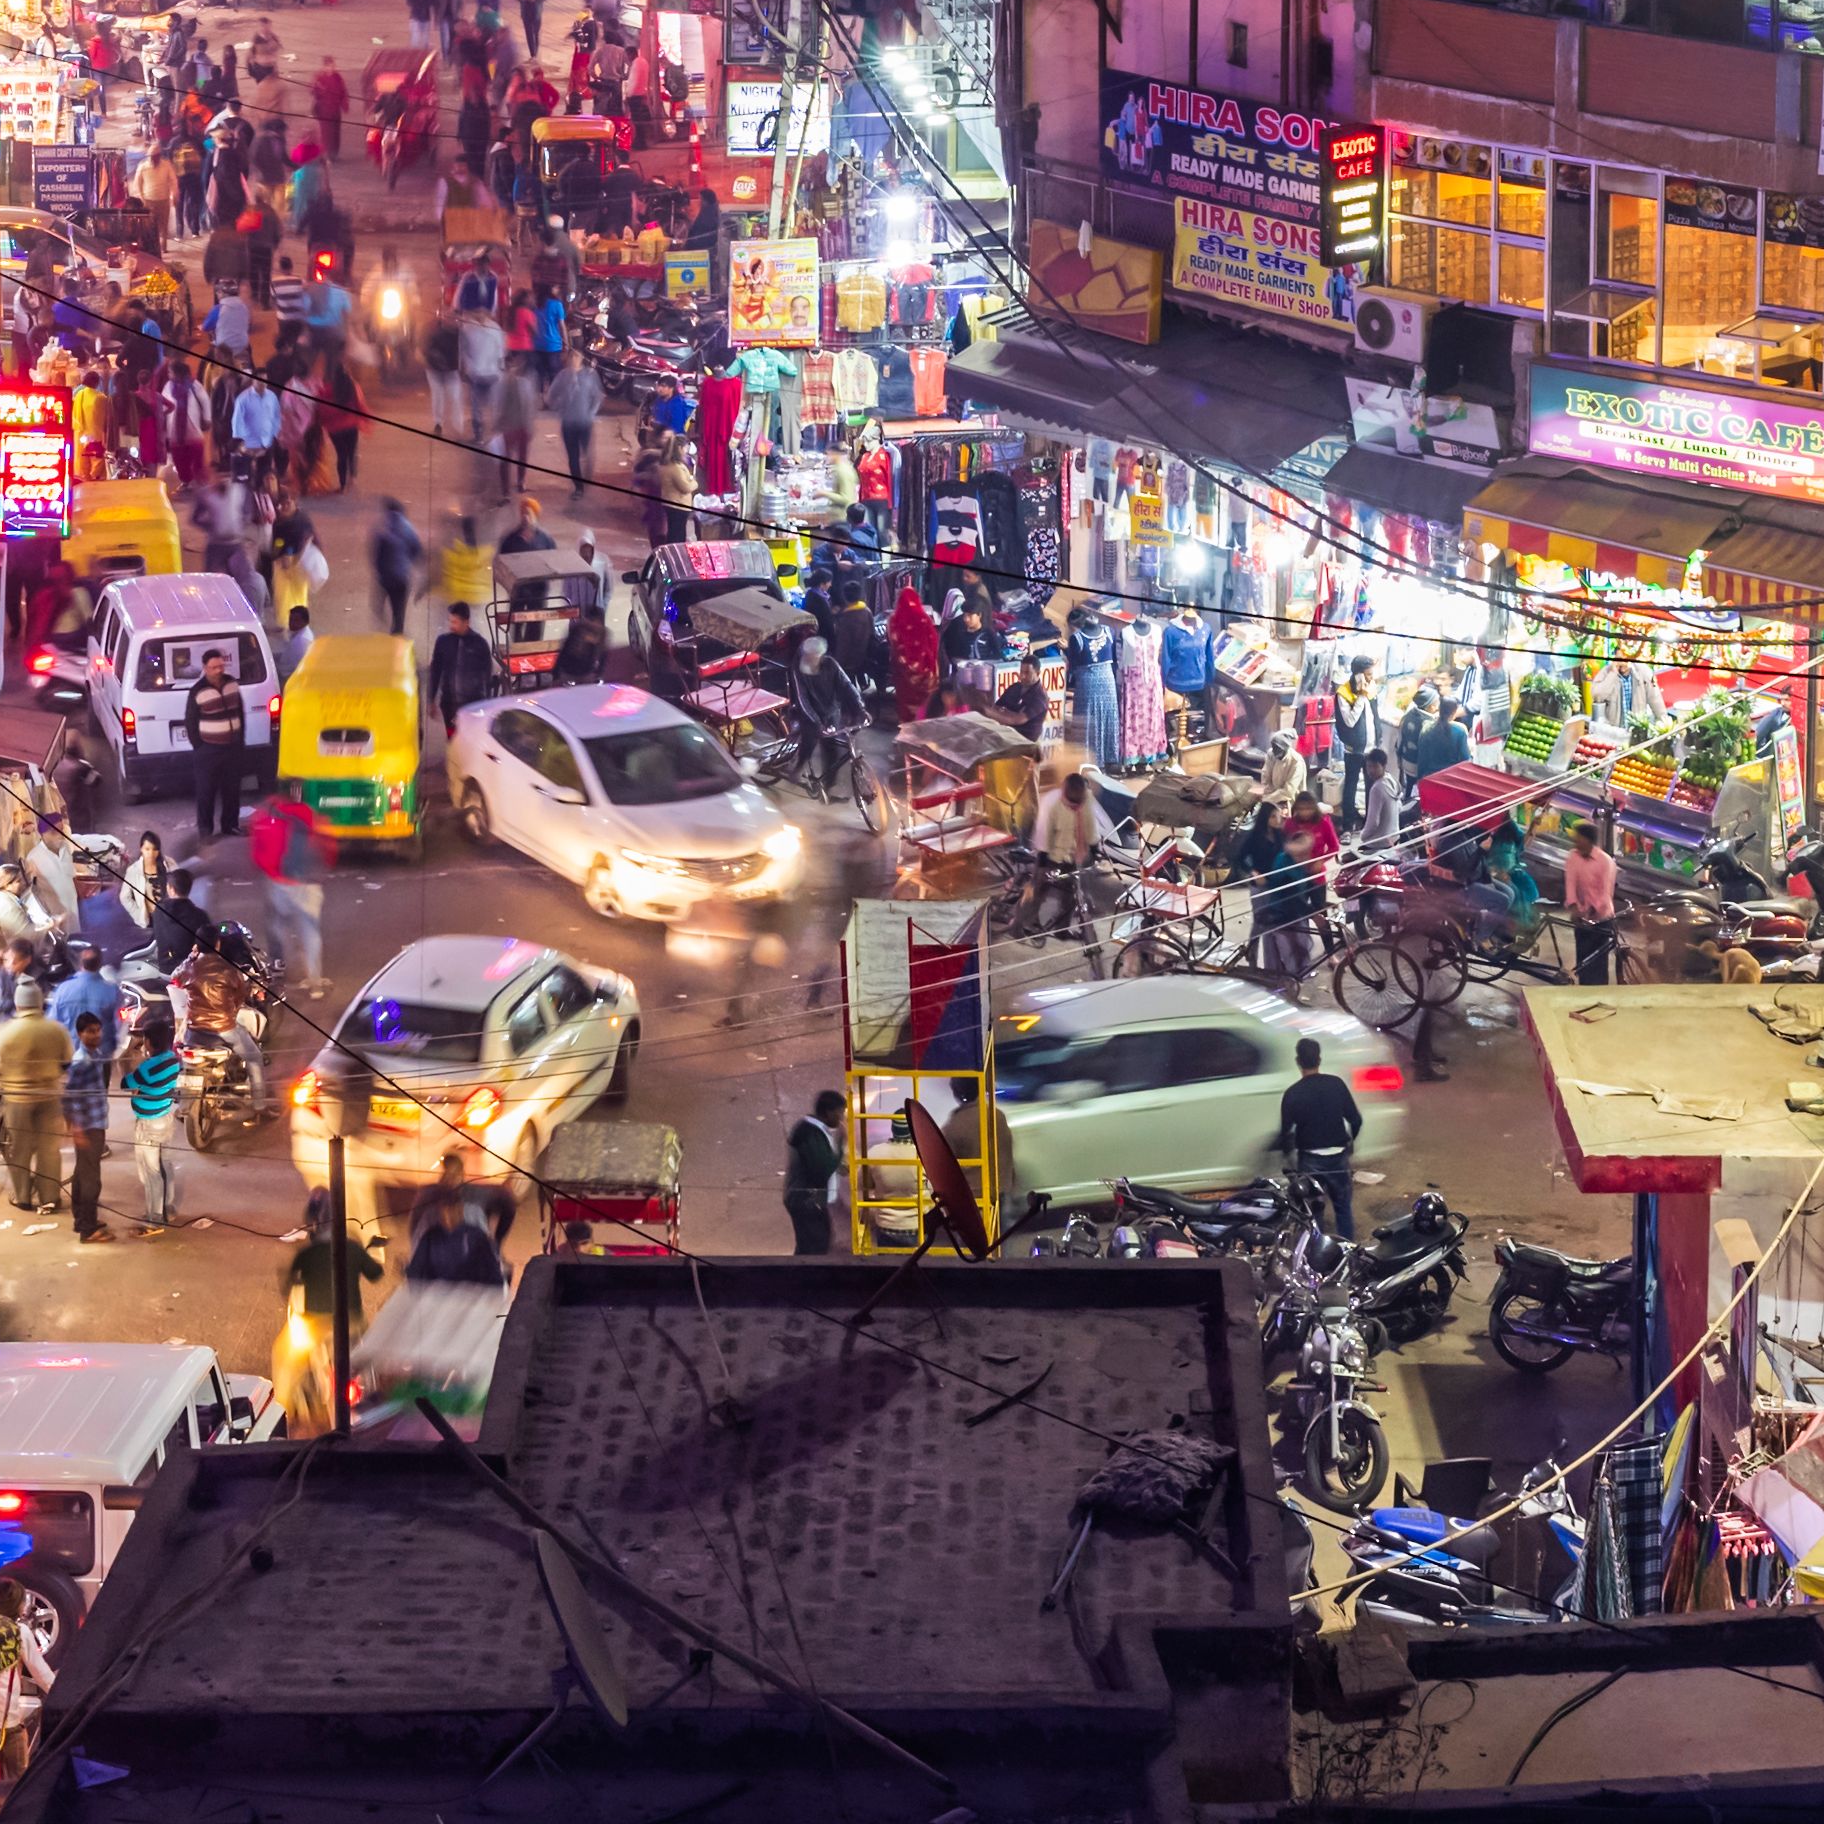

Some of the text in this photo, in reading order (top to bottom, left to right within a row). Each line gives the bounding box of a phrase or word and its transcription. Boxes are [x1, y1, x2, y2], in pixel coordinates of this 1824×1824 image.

[741, 86, 774, 97] NIGHT
[1149, 84, 1245, 137] HIRA
[1191, 134, 1257, 164] हीरा
[1333, 136, 1376, 159] EXOTIC
[38, 164, 86, 173] EXPORTERS
[1171, 154, 1263, 190] READY MADE
[40, 184, 84, 193] CASHMERE
[1168, 176, 1313, 219] COMPLETE FAMILY
[1182, 199, 1244, 237] HIRA
[1668, 214, 1690, 226] Pizza
[1198, 236, 1306, 275] हीरा संस
[1190, 255, 1315, 297] READY MADE GARMENTS
[1192, 274, 1330, 319] COMPLETE FAMILY SHOP
[1566, 388, 1711, 439] EXOTIC
[1595, 426, 1664, 447] Breakfast
[1683, 440, 1727, 456] Lunch
[1746, 450, 1797, 468] Dinner
[1614, 448, 1745, 482] We Serve Multi Cuisine
